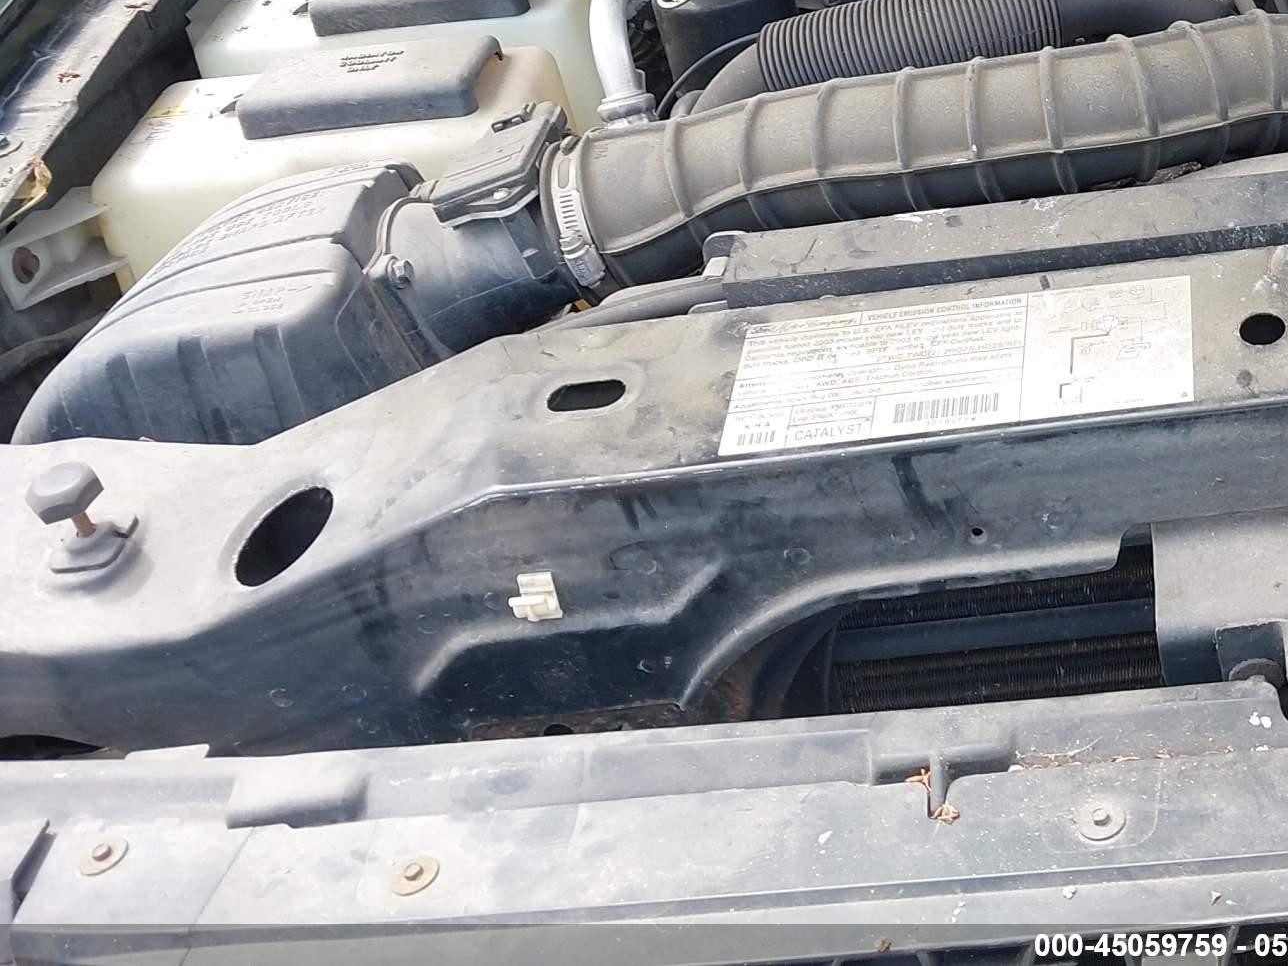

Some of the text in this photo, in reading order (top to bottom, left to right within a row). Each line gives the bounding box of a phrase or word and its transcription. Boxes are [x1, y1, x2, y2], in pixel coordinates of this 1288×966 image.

[867, 310, 897, 321] VEHICLE
[936, 303, 971, 314] CONTROL
[971, 298, 1023, 309] INFORMATION
[794, 423, 865, 442] CATALYST
